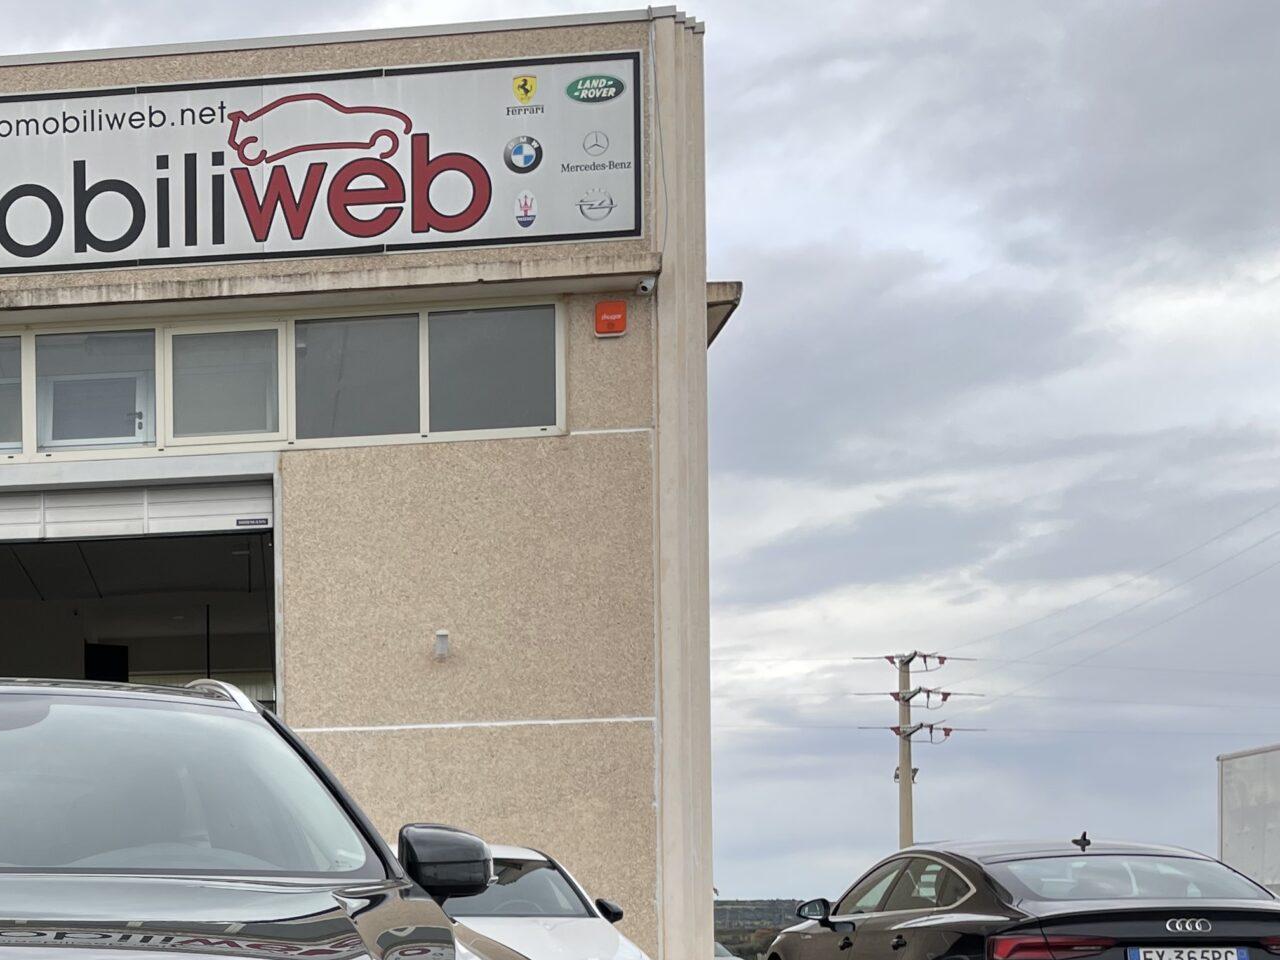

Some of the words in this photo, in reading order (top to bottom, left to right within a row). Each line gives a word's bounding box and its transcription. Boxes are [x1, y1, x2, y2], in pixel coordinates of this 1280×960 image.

[577, 78, 606, 89] LAND
[580, 87, 616, 99] ROVER
[506, 105, 545, 116] Ferrari
[561, 161, 632, 173] Mercedes-Benz
